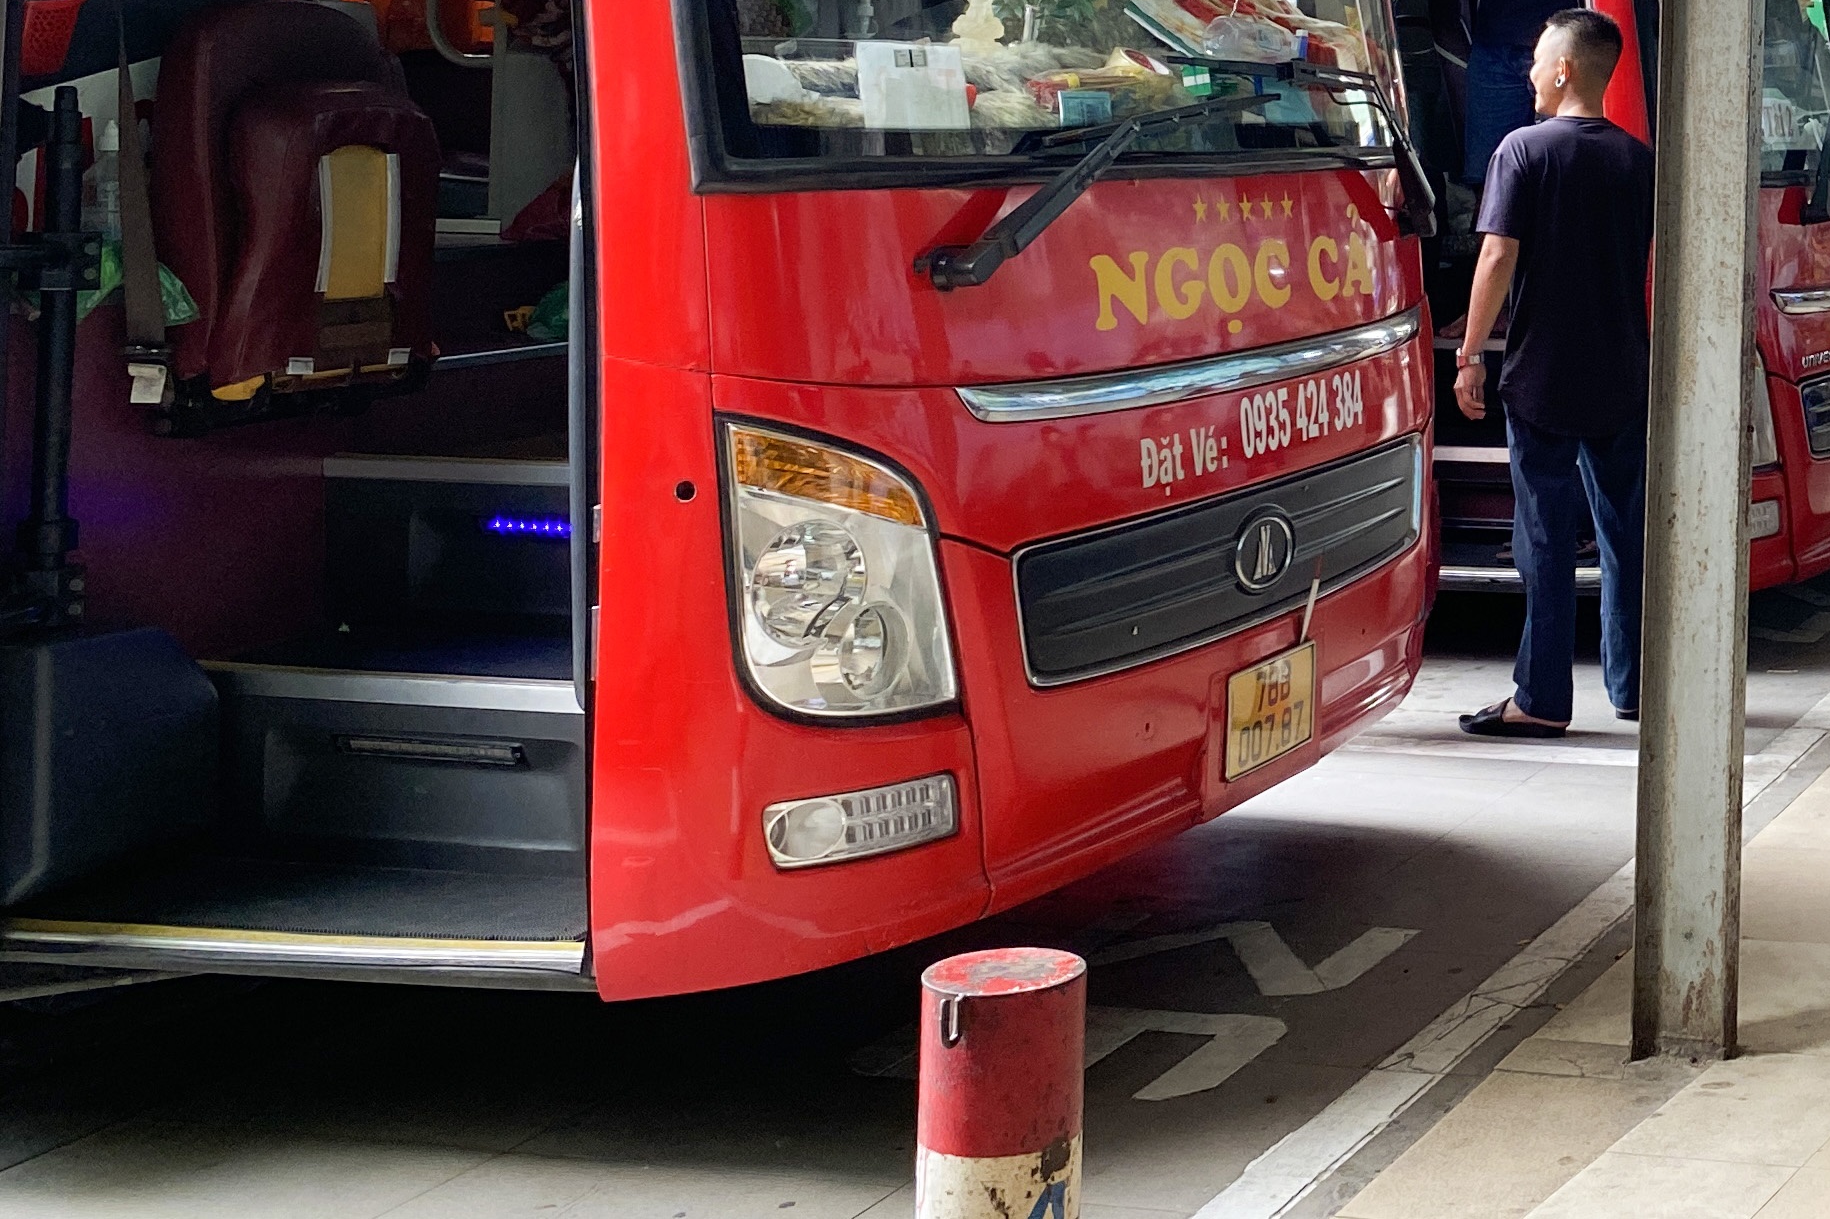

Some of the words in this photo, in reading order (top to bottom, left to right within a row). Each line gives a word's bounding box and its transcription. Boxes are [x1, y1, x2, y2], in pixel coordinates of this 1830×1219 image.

[1089, 237, 1292, 333] NGỌC
[1140, 427, 1184, 496] Đặt
[1239, 388, 1291, 460] 0935
[1295, 382, 1330, 442] 424
[1332, 370, 1363, 431] 384
[1238, 700, 1304, 768] 007.87
